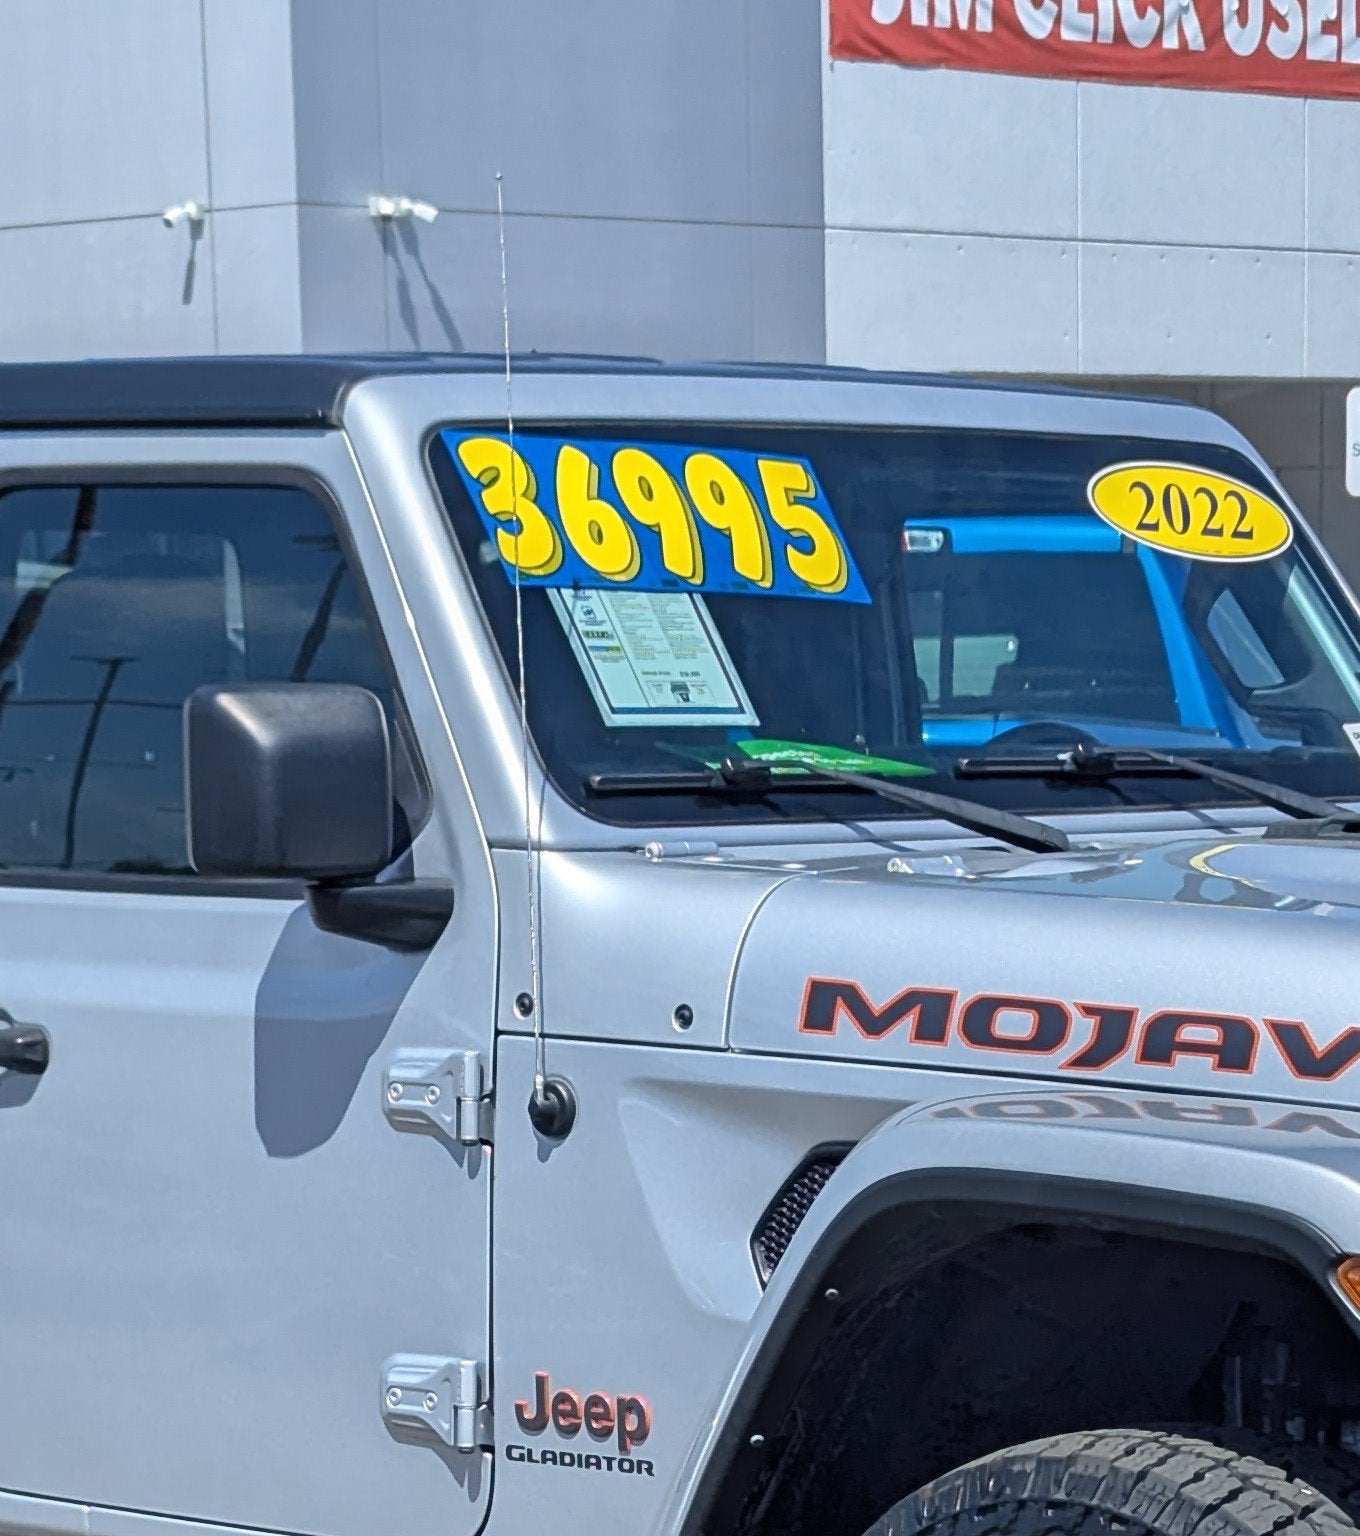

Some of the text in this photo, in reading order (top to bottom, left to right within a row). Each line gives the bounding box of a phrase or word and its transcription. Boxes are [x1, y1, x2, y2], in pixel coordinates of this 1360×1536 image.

[457, 437, 848, 593] 36995
[1128, 481, 1255, 541] 2022
[514, 1370, 653, 1456] Jeep
[505, 1443, 655, 1478] GLADIATOR
